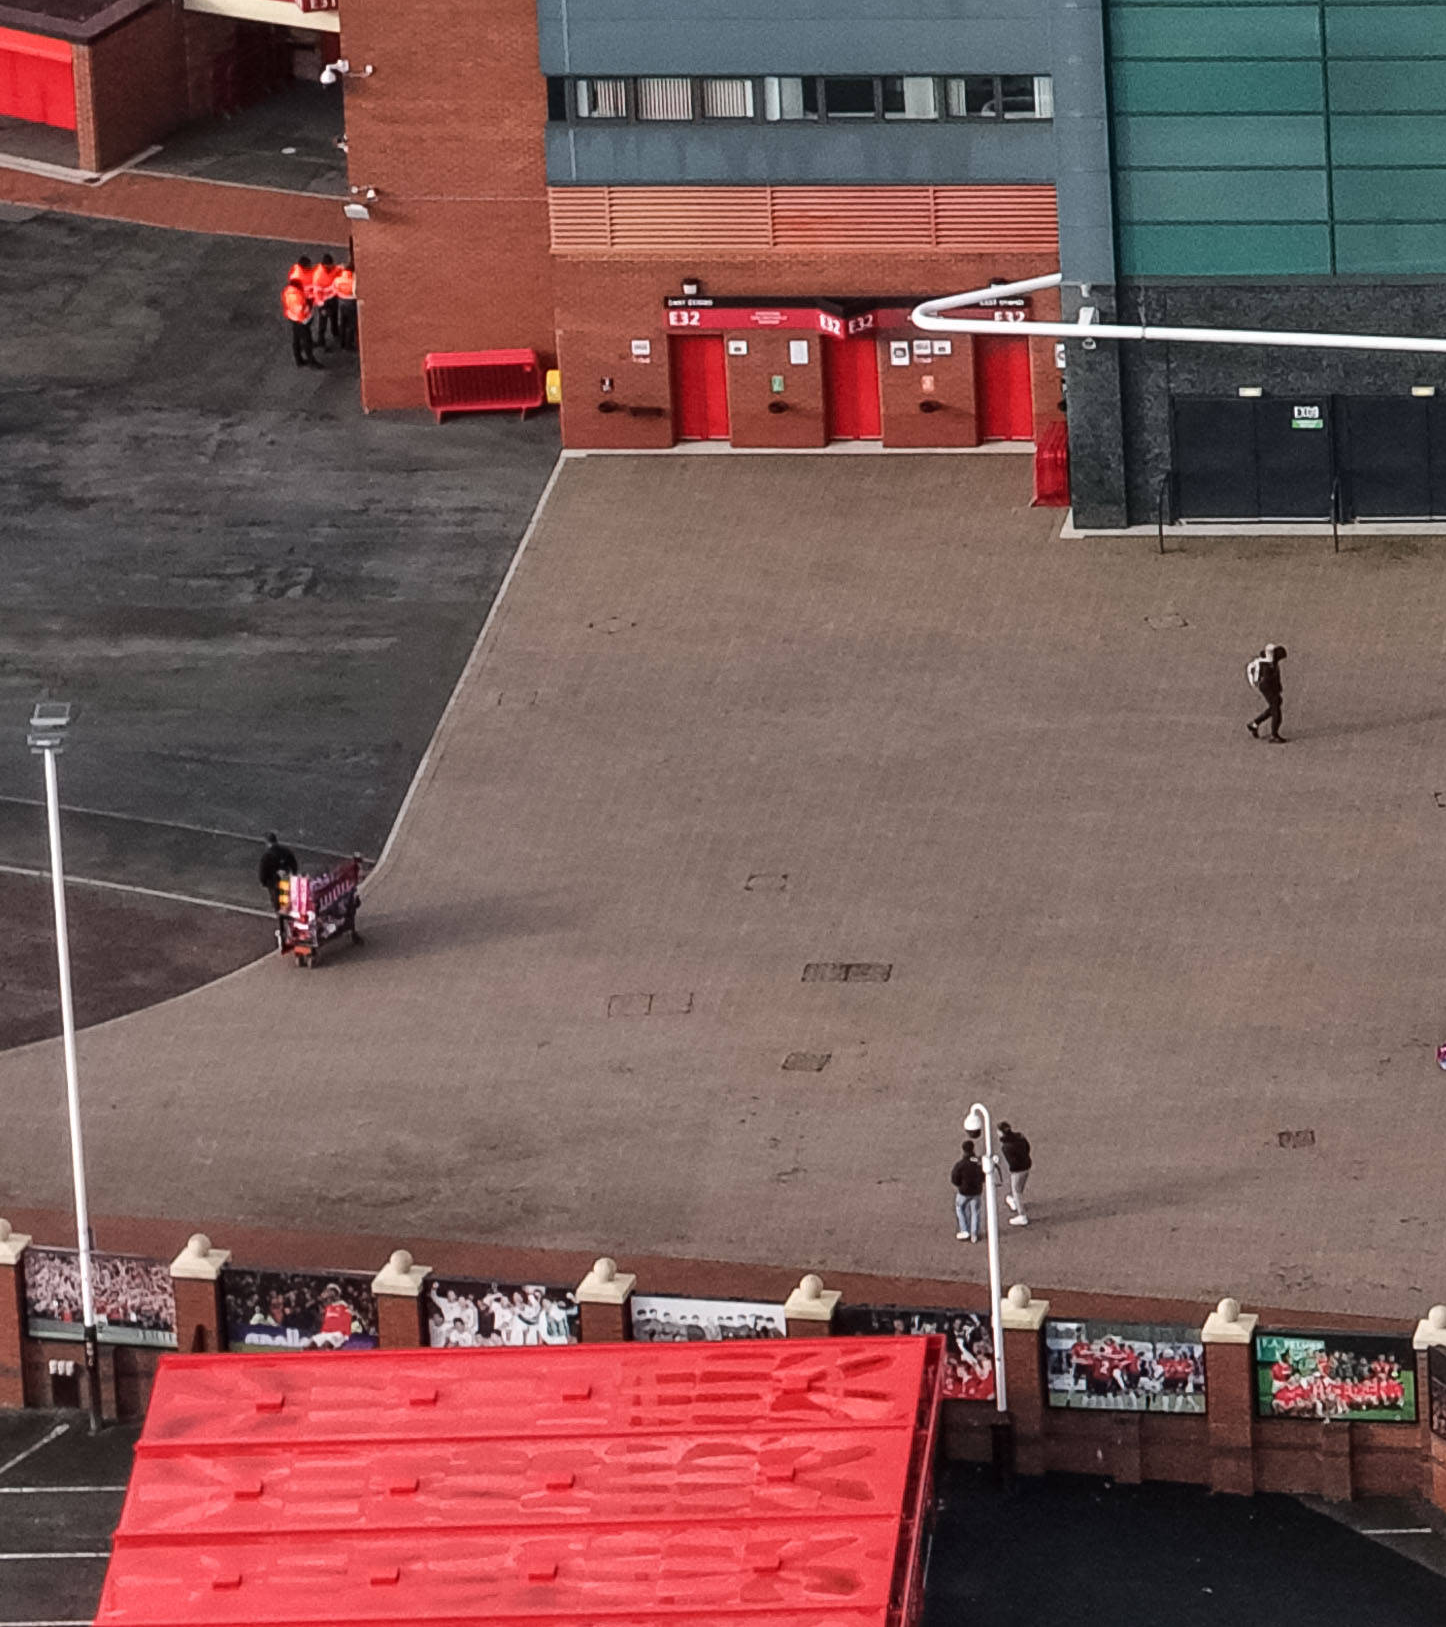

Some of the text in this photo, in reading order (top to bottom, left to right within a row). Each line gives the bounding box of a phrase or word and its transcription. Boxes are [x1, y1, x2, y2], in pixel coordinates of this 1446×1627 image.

[668, 310, 701, 326] E32
[819, 313, 842, 335] E32
[848, 314, 874, 334] E32
[993, 310, 1026, 323] E32
